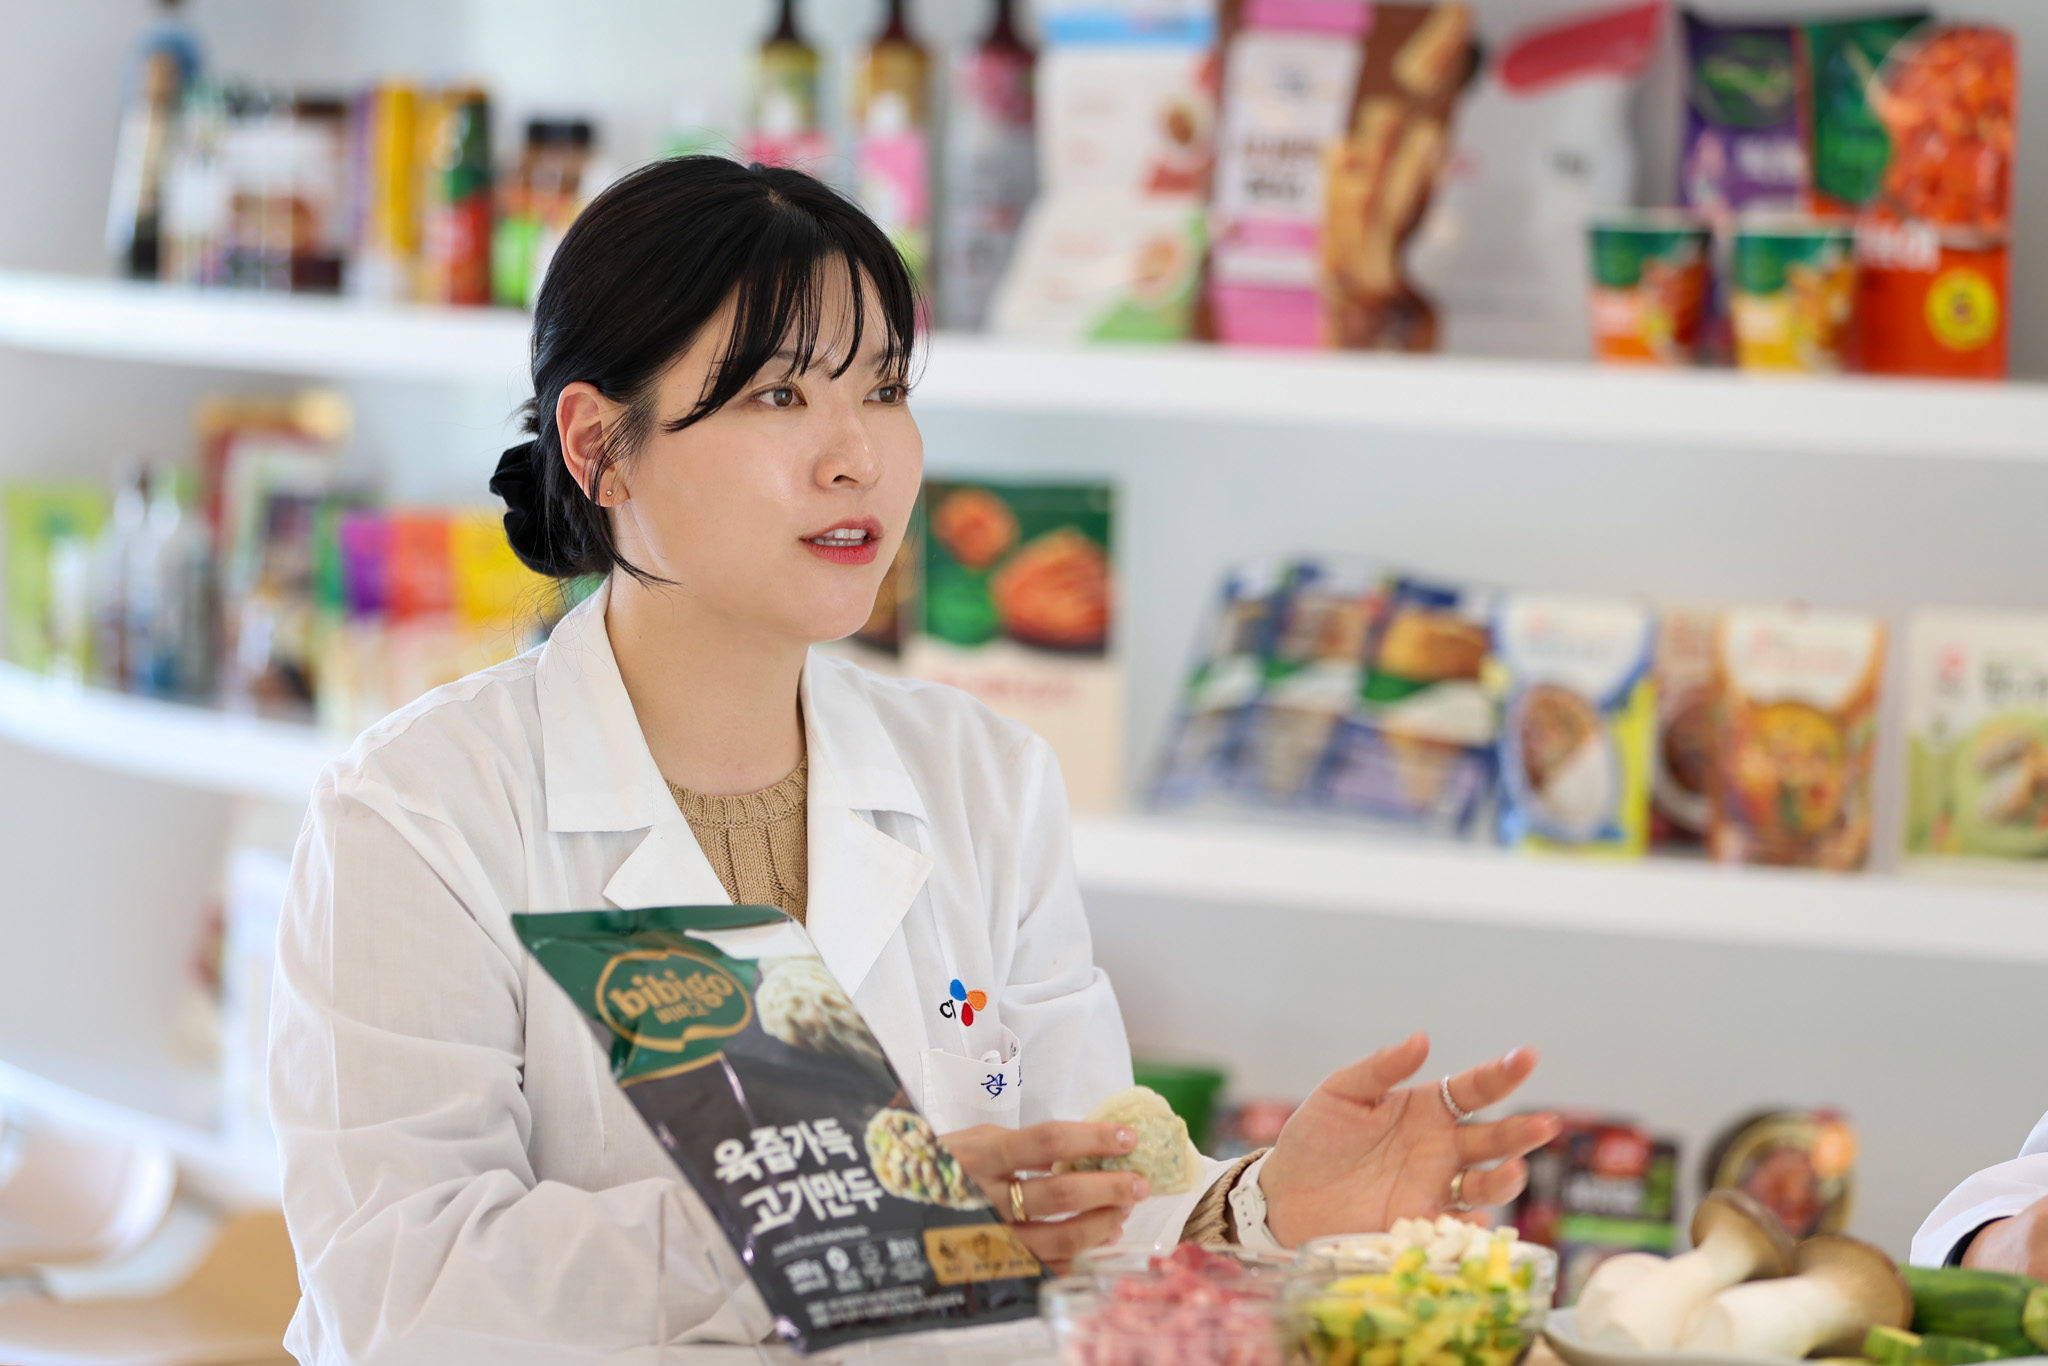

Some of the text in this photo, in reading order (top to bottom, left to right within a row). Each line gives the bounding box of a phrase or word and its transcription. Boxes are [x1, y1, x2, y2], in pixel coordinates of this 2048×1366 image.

[609, 969, 734, 1019] bibigo
[714, 1117, 859, 1184] 육즙가득
[739, 1166, 883, 1236] 고기만두
